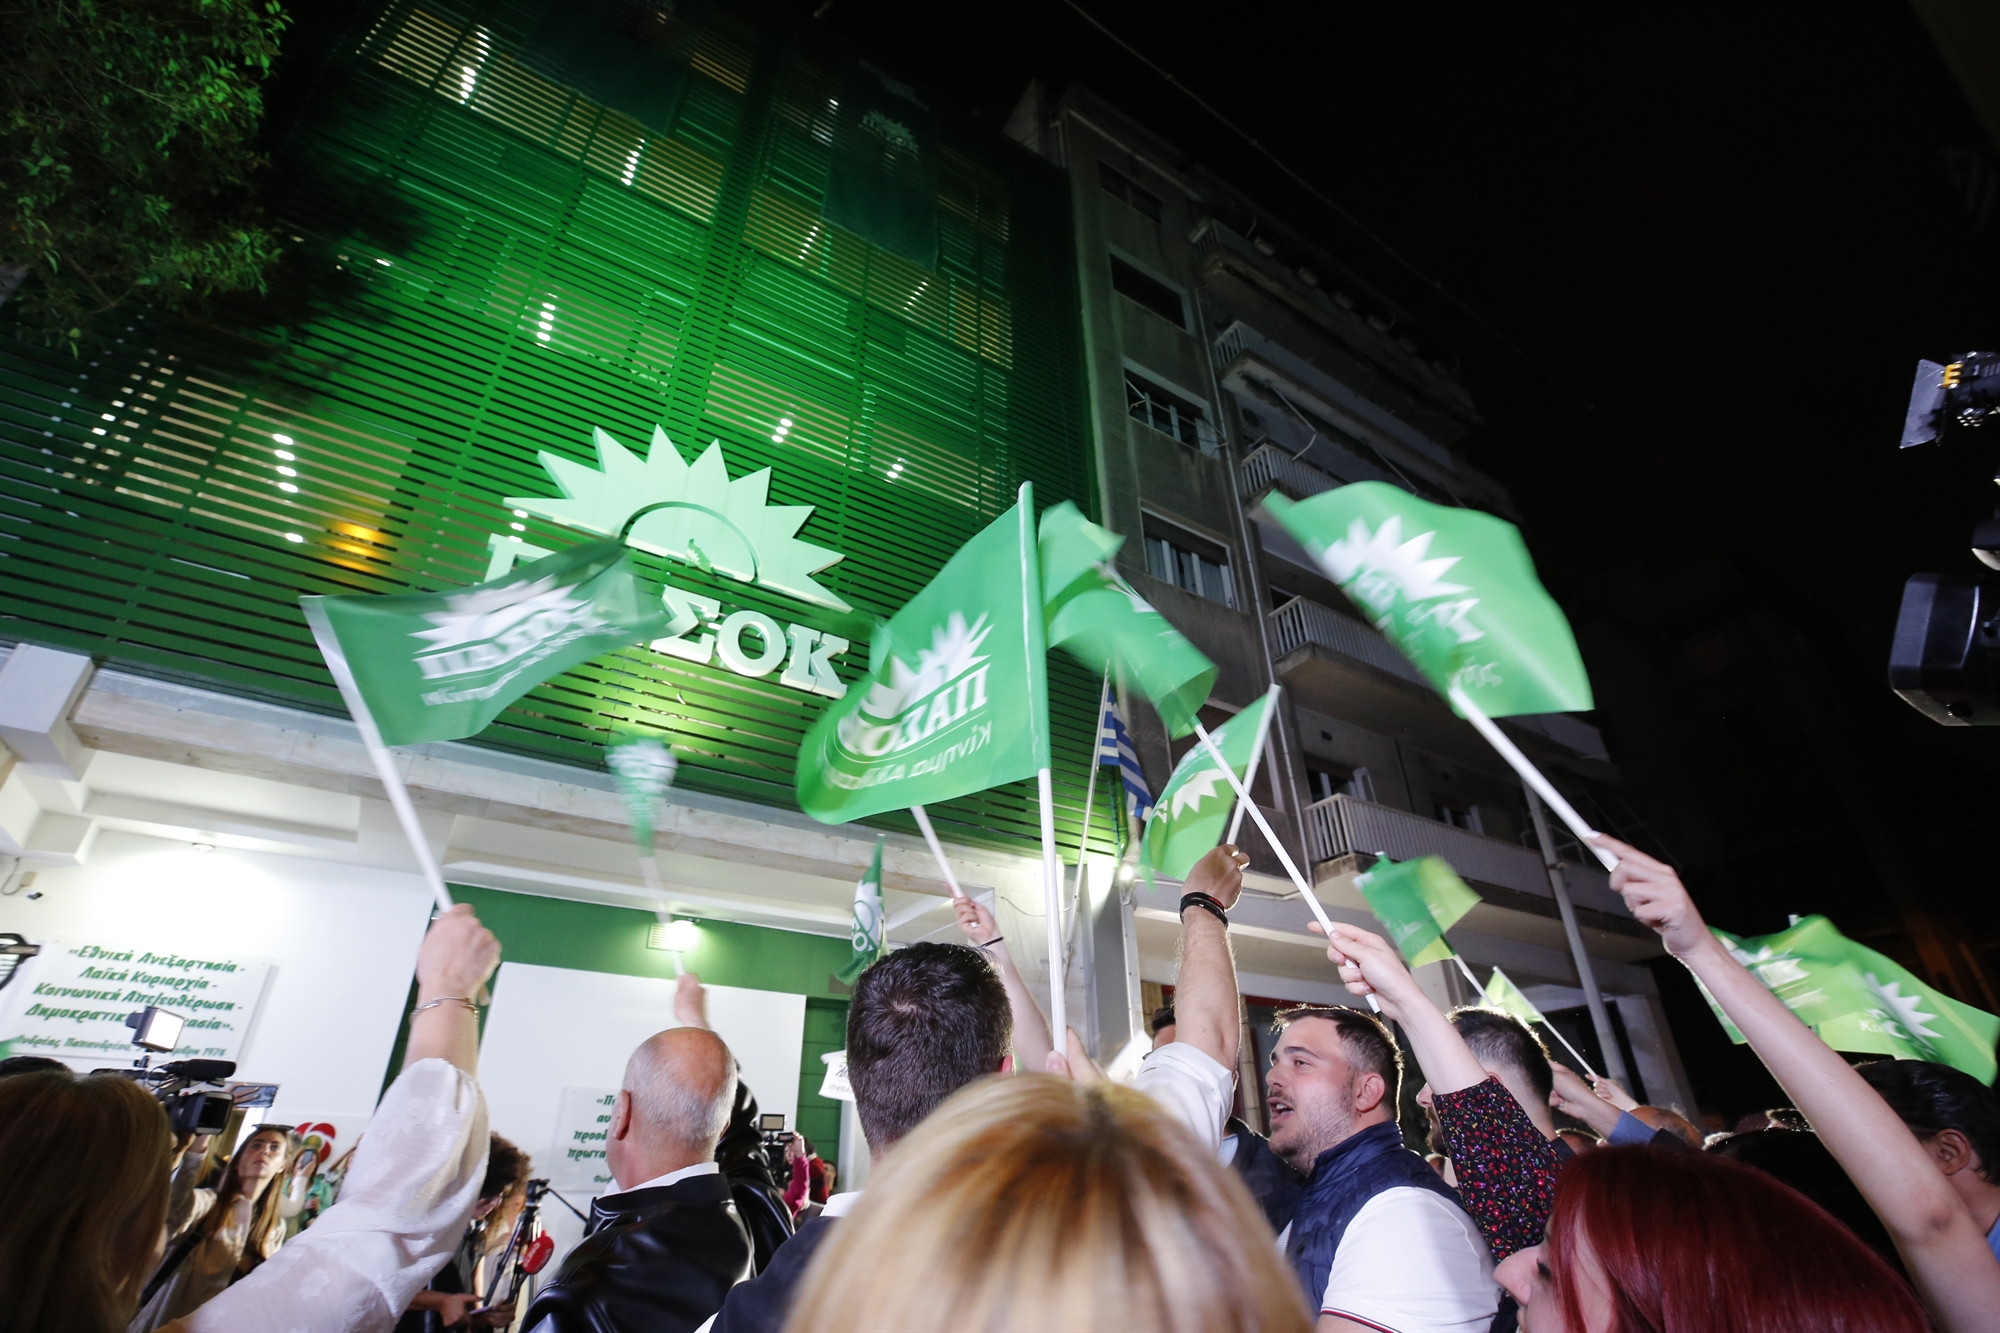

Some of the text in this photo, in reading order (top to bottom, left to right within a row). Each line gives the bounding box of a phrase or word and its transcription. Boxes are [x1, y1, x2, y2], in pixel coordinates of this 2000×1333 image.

[68, 945, 135, 962] «Εθνική
[137, 952, 237, 973] Ανεξαρτησία
[78, 966, 129, 982] Λαϊκή
[130, 971, 210, 992] Κυριαρχία
[32, 982, 122, 1002] Κοινωνική
[25, 1003, 131, 1024] Δημοκρατικ
